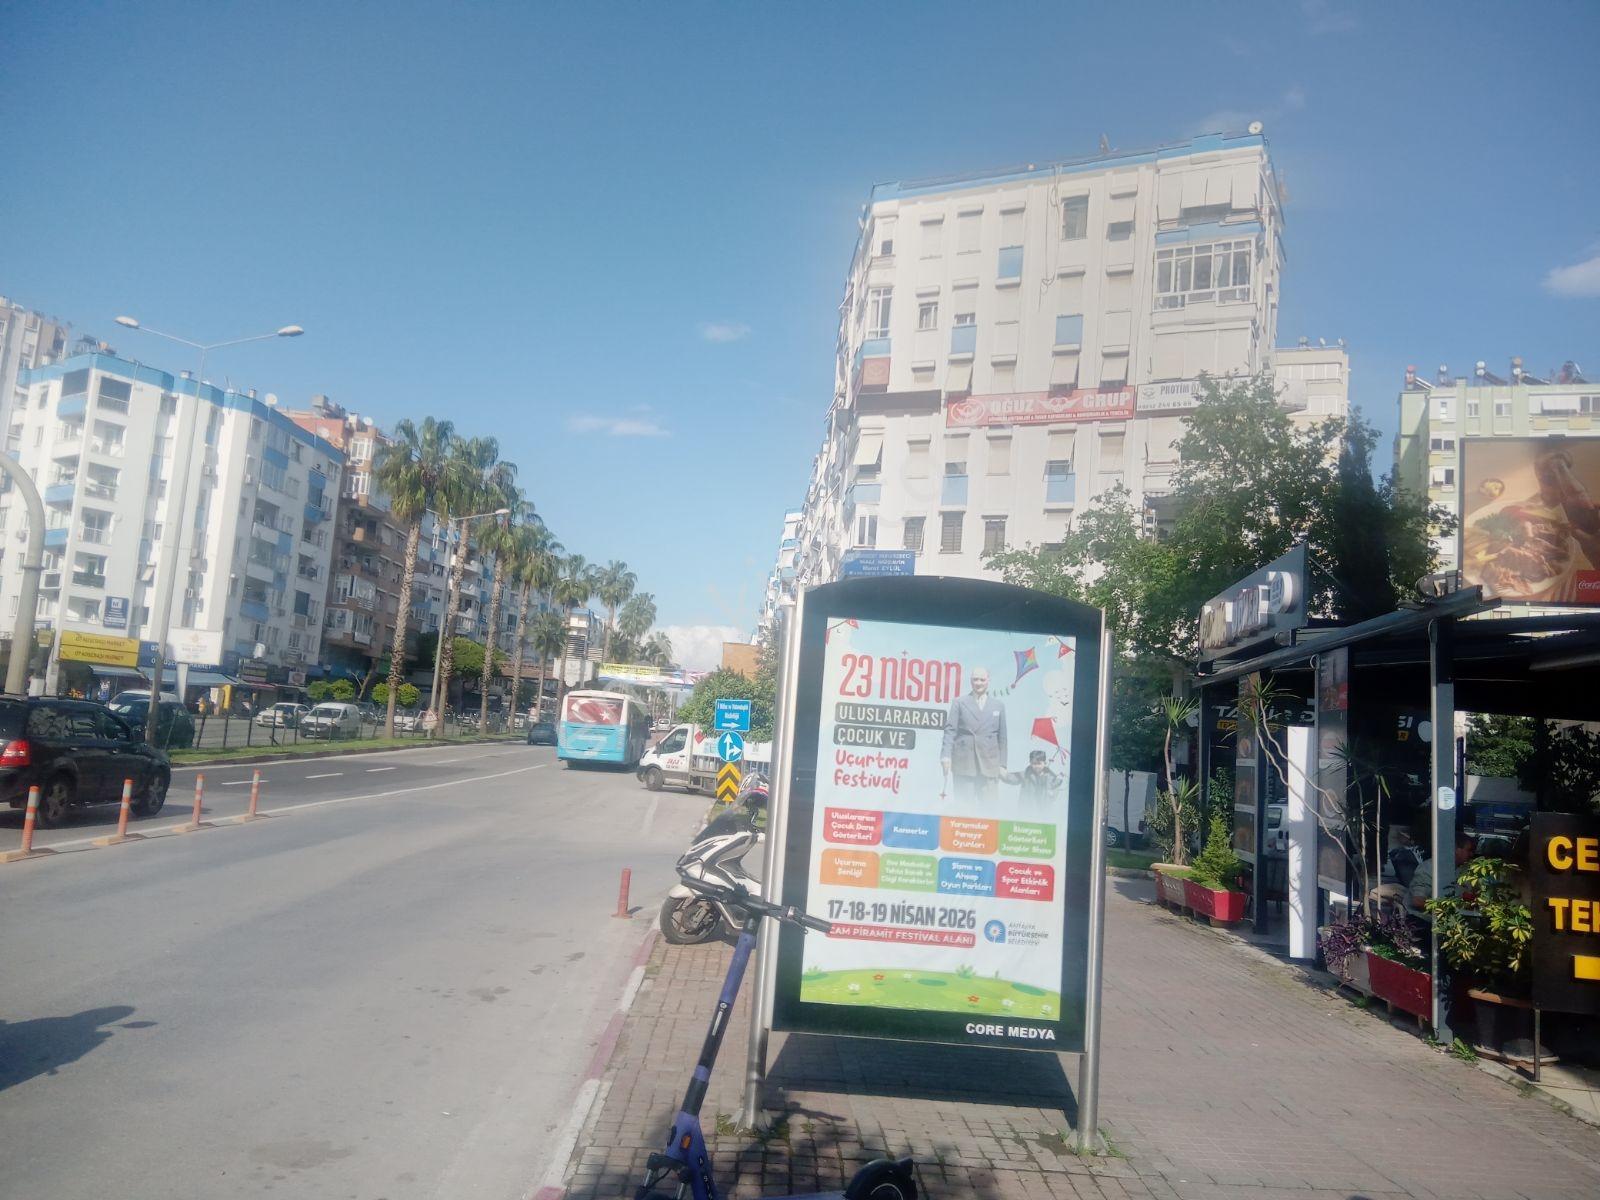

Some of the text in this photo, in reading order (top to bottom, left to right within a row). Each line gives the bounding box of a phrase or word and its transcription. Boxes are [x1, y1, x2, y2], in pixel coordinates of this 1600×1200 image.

[1082, 392, 1131, 408] GRUP
[839, 653, 873, 698] 23
[838, 705, 944, 727] ULUSLARARASI
[837, 728, 906, 747] ÇOCUK VE
[835, 749, 909, 770] Uçurtma
[827, 899, 976, 930] 17-18-19 NİSAN 2026
[853, 926, 893, 939] PİRAMİT
[895, 930, 941, 943] FESTİVAL
[942, 933, 974, 945] ALANI
[965, 1022, 1056, 1041] CORE MEDYA
